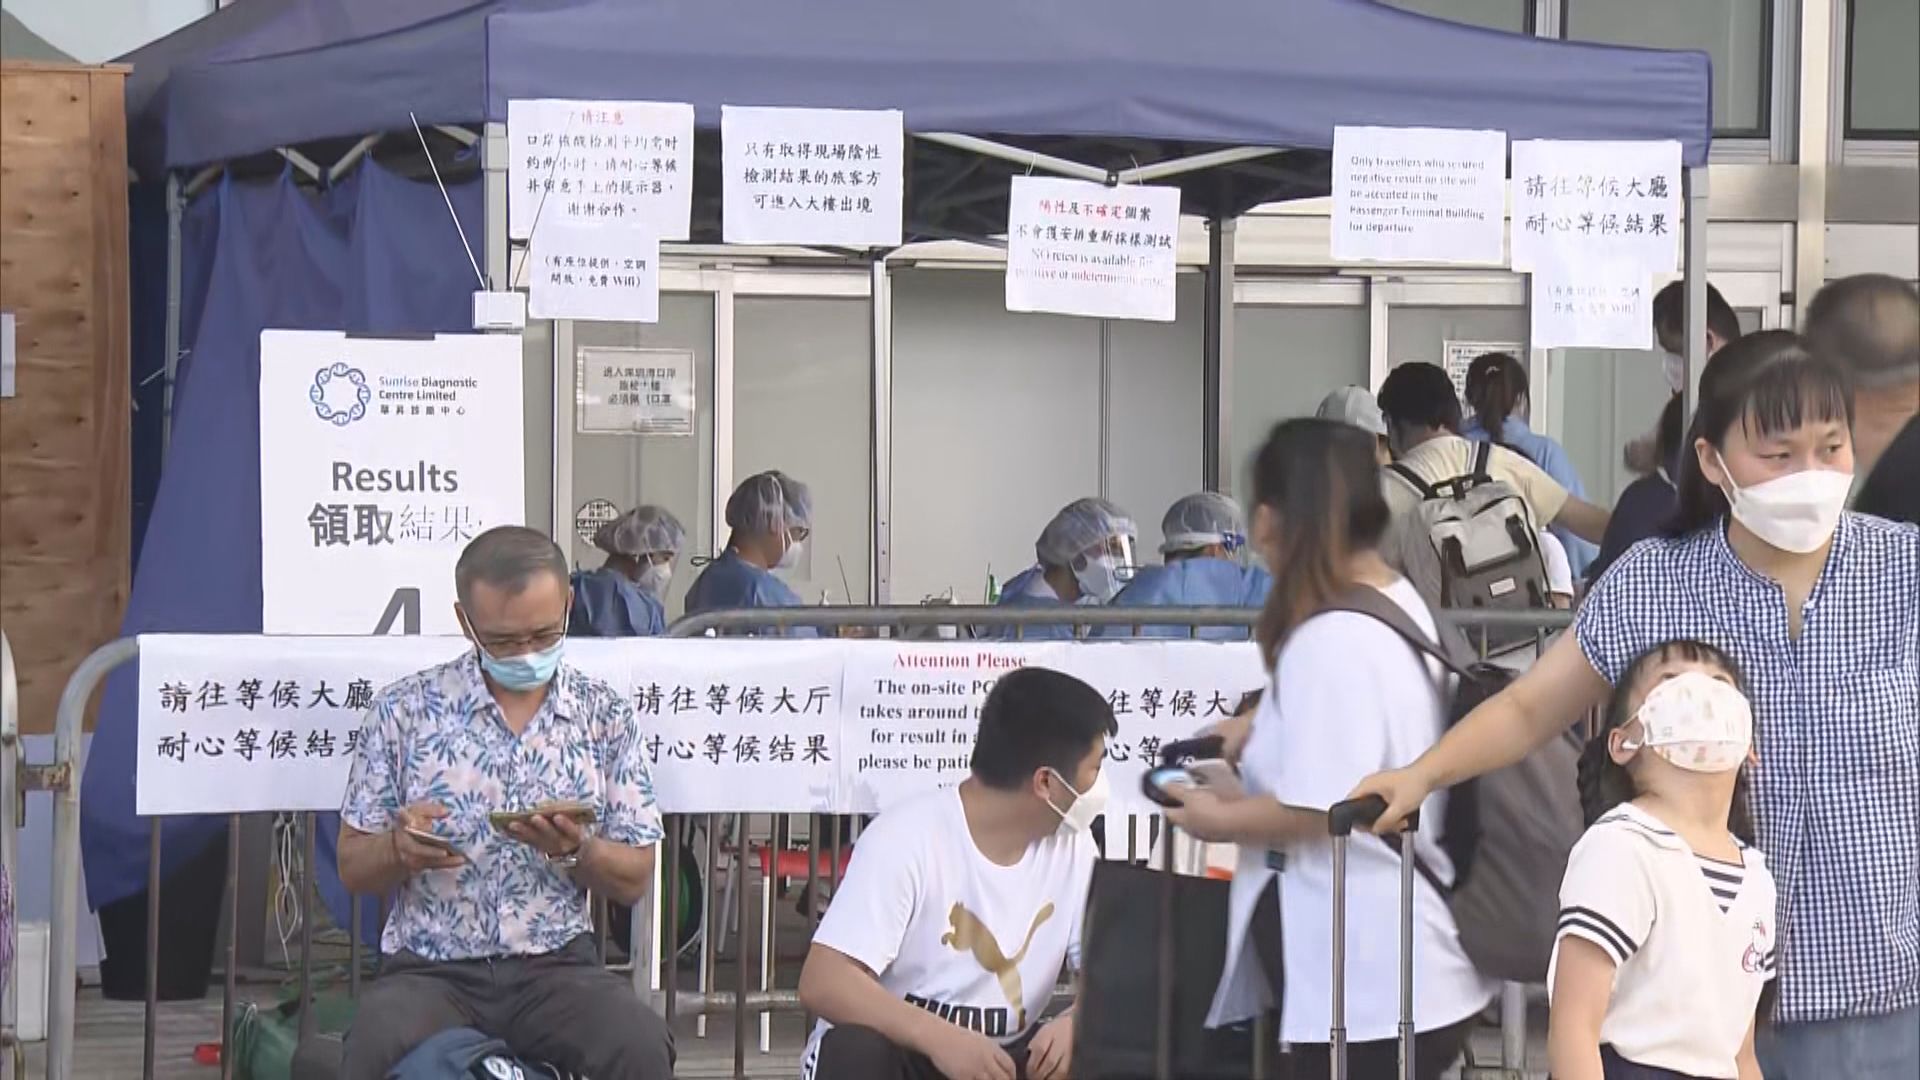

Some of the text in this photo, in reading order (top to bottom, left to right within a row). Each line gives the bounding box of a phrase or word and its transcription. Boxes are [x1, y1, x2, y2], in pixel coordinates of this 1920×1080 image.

[745, 143, 882, 160] 只有取得現場陰性
[1351, 156, 1373, 167] Only
[1376, 157, 1421, 167] travellers
[1425, 159, 1444, 168] who
[744, 168, 880, 186] 檢測結果的旅客方
[1351, 173, 1392, 183] negative
[1395, 175, 1421, 184] result
[1425, 176, 1436, 184] on
[1459, 177, 1476, 185] will
[753, 194, 872, 213] 可進入大樓出境
[1411, 192, 1419, 200] in
[1423, 191, 1438, 201] the
[1350, 205, 1484, 220] Passenger Terminal Building
[1350, 221, 1413, 233] for departure
[1525, 212, 1668, 236] 耐心等候結果
[379, 376, 477, 391] Sunrise Diagnostic
[379, 388, 456, 401] Centre Limited
[333, 460, 458, 493] Results
[307, 503, 484, 550] 領取結果
[894, 653, 1029, 670] Attention Please
[157, 677, 374, 713] 請往等候大廳
[874, 680, 905, 694] The
[911, 680, 965, 695] on-site
[634, 682, 832, 716] 请往等候大厅
[861, 704, 902, 719] takes
[908, 705, 967, 719] around
[871, 728, 894, 743] for
[901, 729, 945, 744] result
[952, 728, 967, 744] in
[859, 754, 908, 772] please
[914, 754, 931, 769] be
